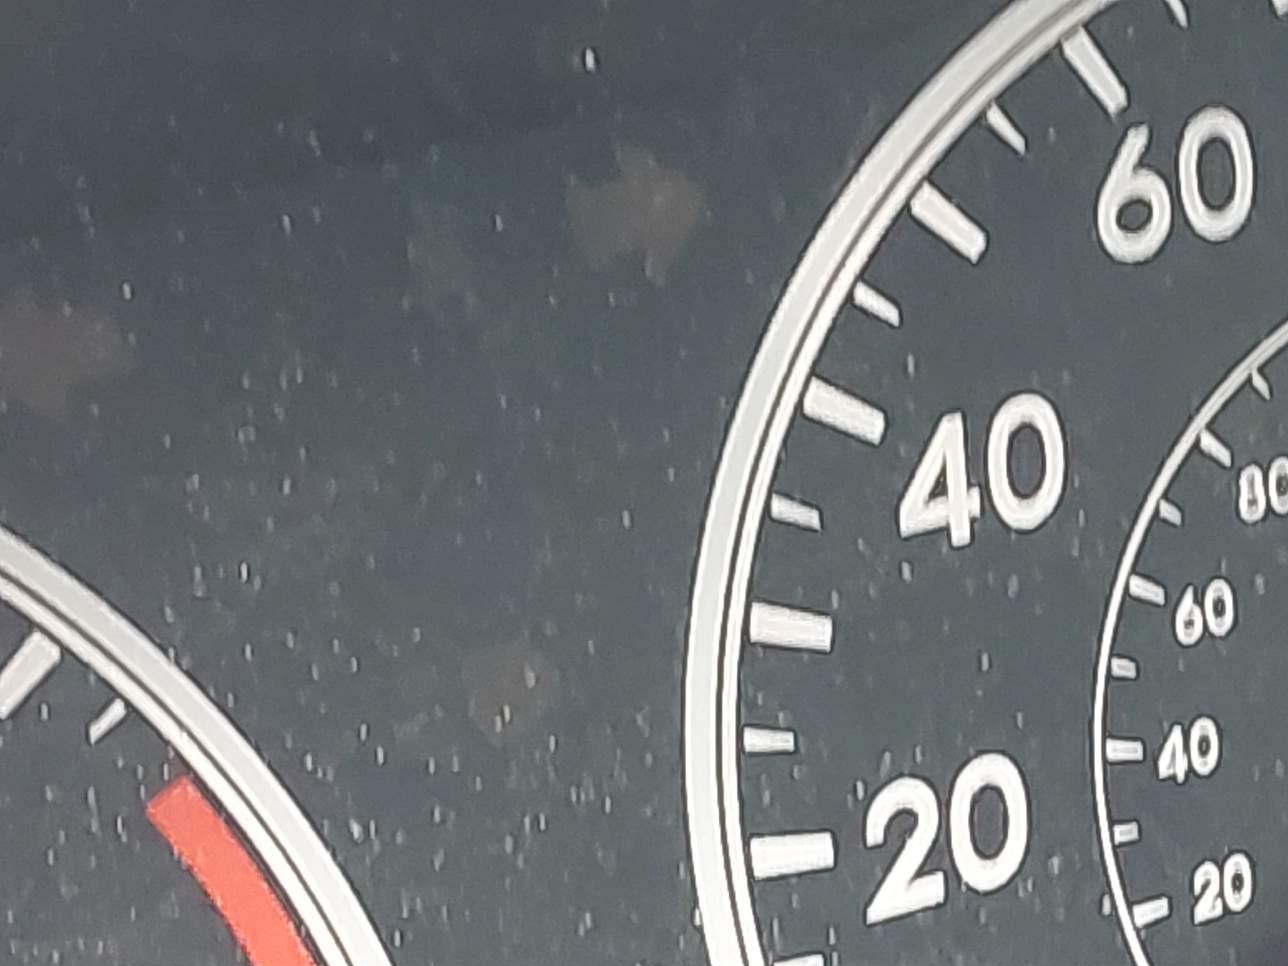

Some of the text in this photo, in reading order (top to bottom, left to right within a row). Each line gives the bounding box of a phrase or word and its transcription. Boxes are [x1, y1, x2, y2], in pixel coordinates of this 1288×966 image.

[1096, 105, 1255, 264] 60
[898, 393, 1066, 548] 40
[1174, 578, 1235, 646] 60
[1157, 717, 1220, 784] 40
[865, 752, 1029, 925] 20
[1193, 852, 1253, 925] 20
